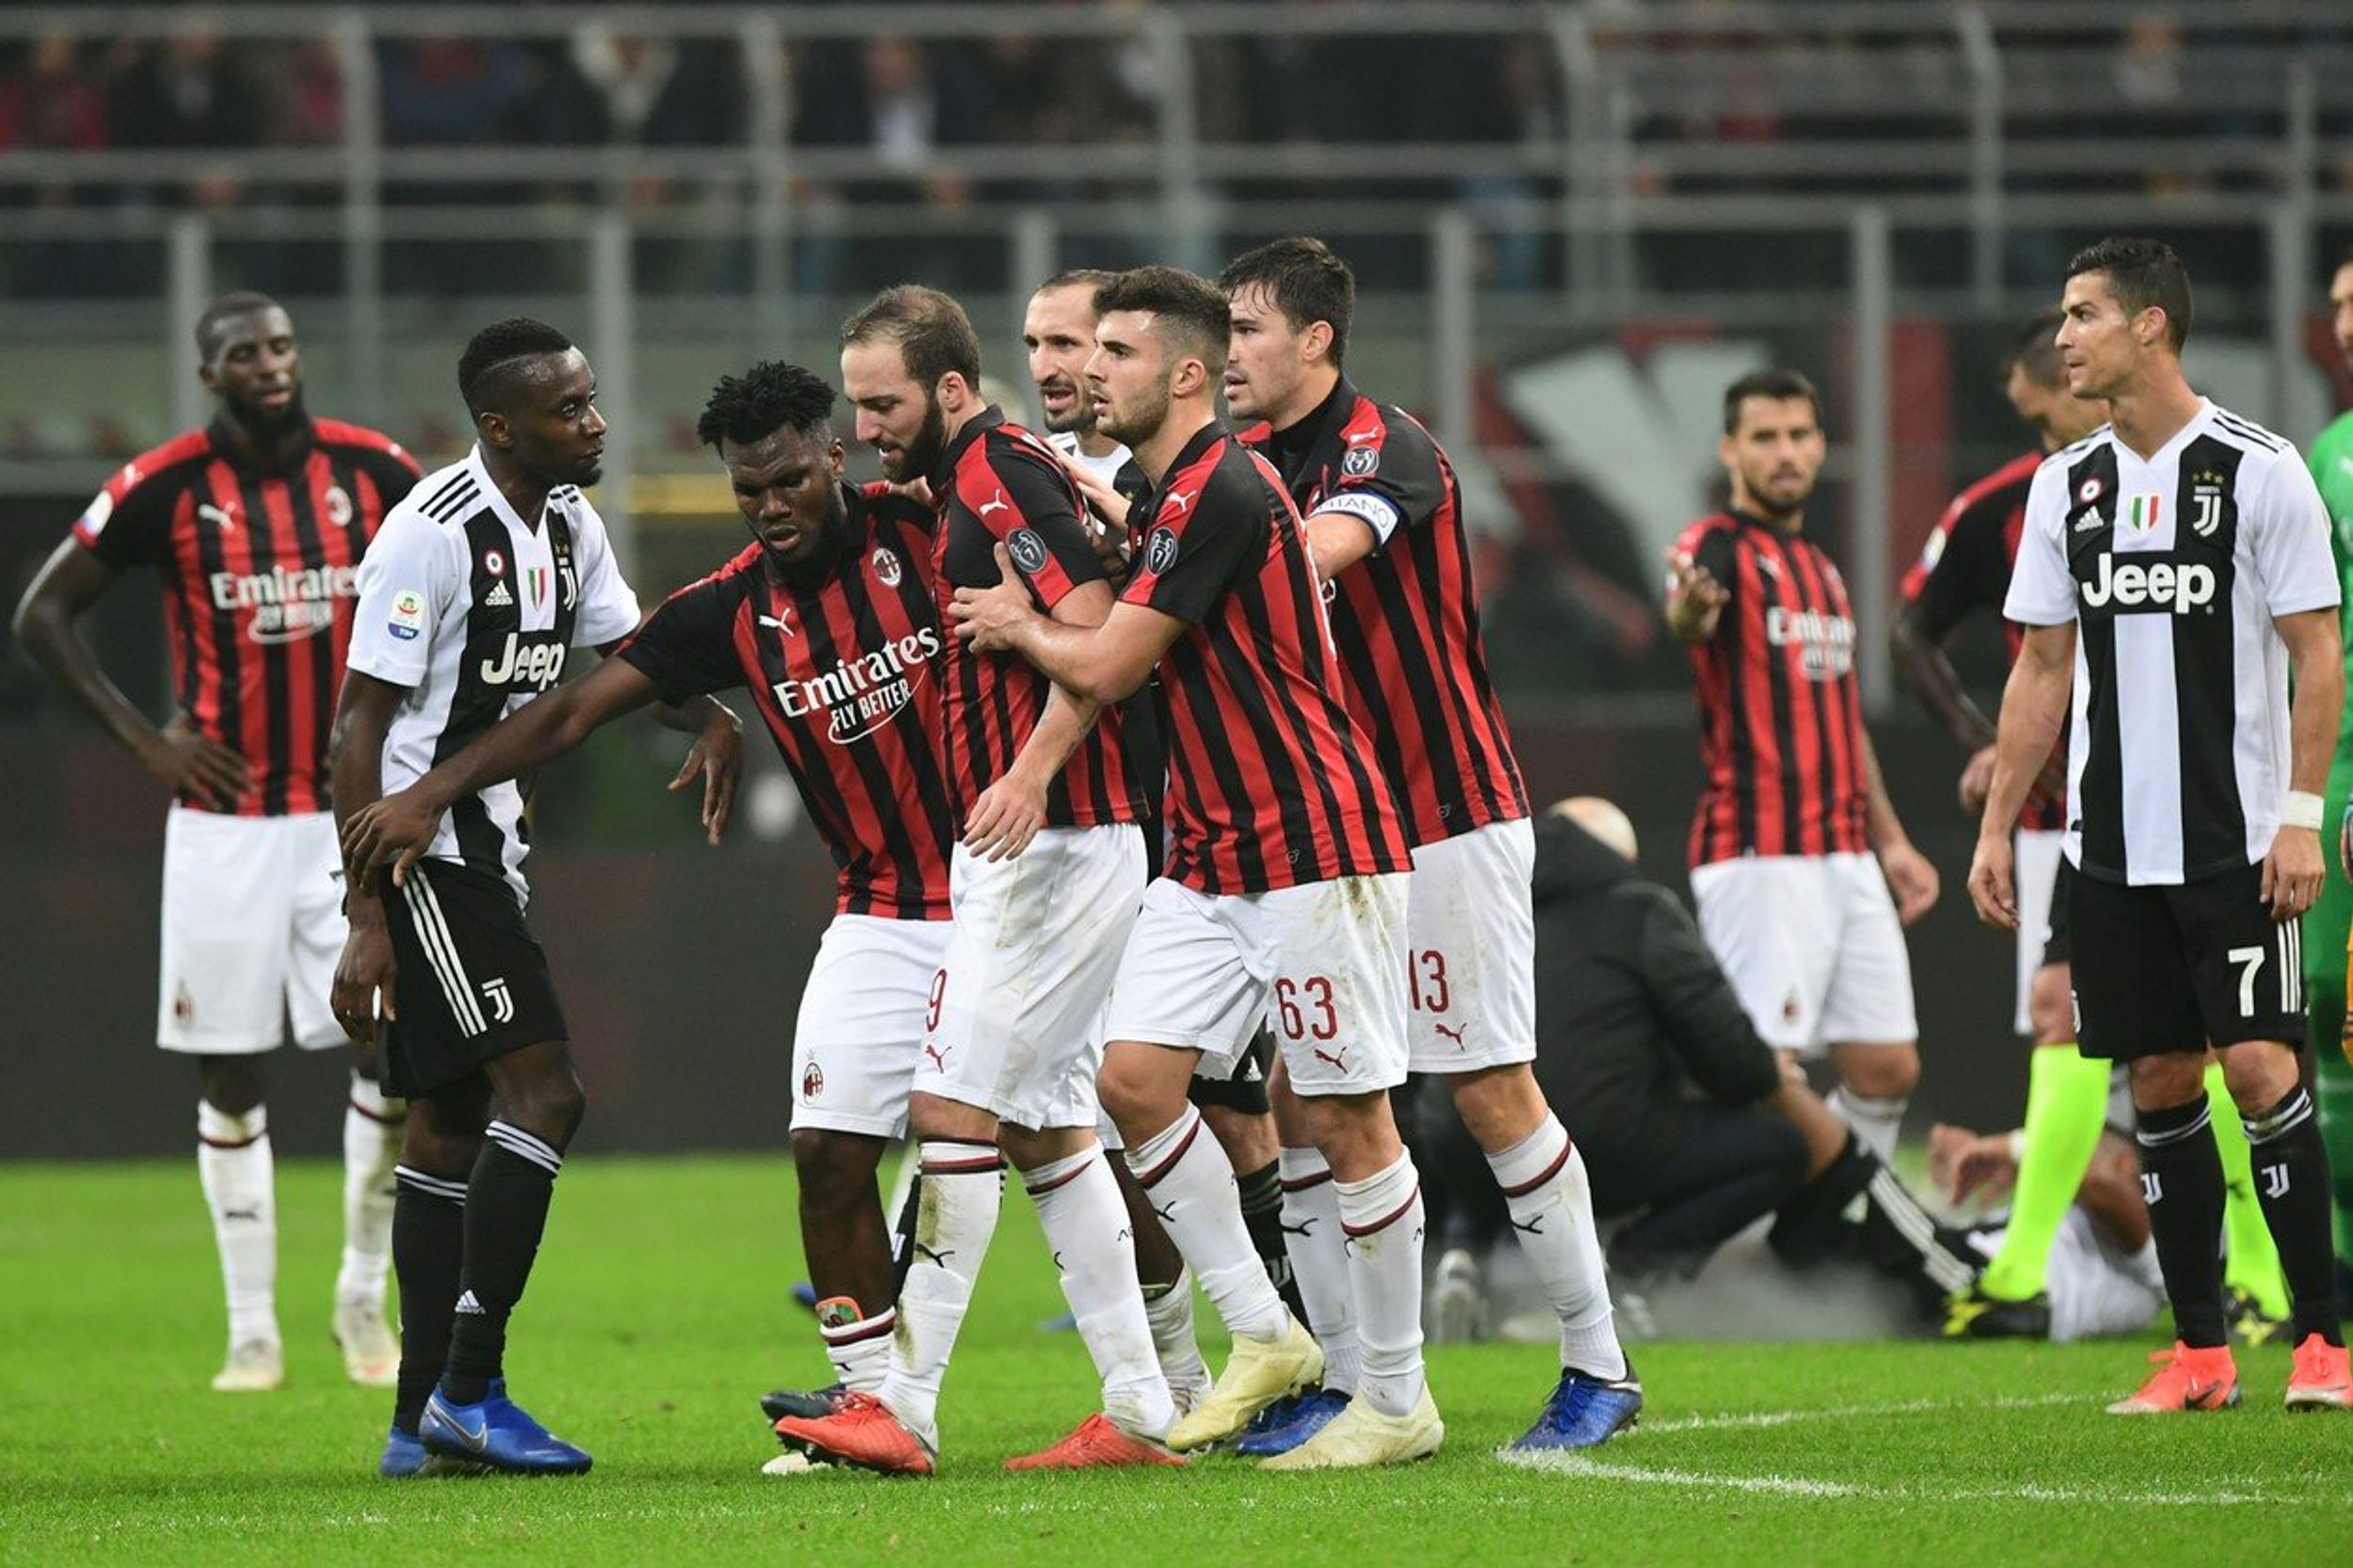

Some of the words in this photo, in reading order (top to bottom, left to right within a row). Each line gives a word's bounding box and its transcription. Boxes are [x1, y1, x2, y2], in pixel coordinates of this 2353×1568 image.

[210, 565, 360, 609] Emirate
[2083, 552, 2216, 614] Jeep
[480, 632, 565, 692] Jeep
[773, 627, 940, 718] Emirates
[831, 702, 860, 733] FLY
[858, 678, 912, 721] BETTER
[926, 969, 947, 1032] 9
[1275, 977, 1337, 1040] 63
[1409, 949, 1448, 1013] 13
[2228, 946, 2266, 1018] 7
